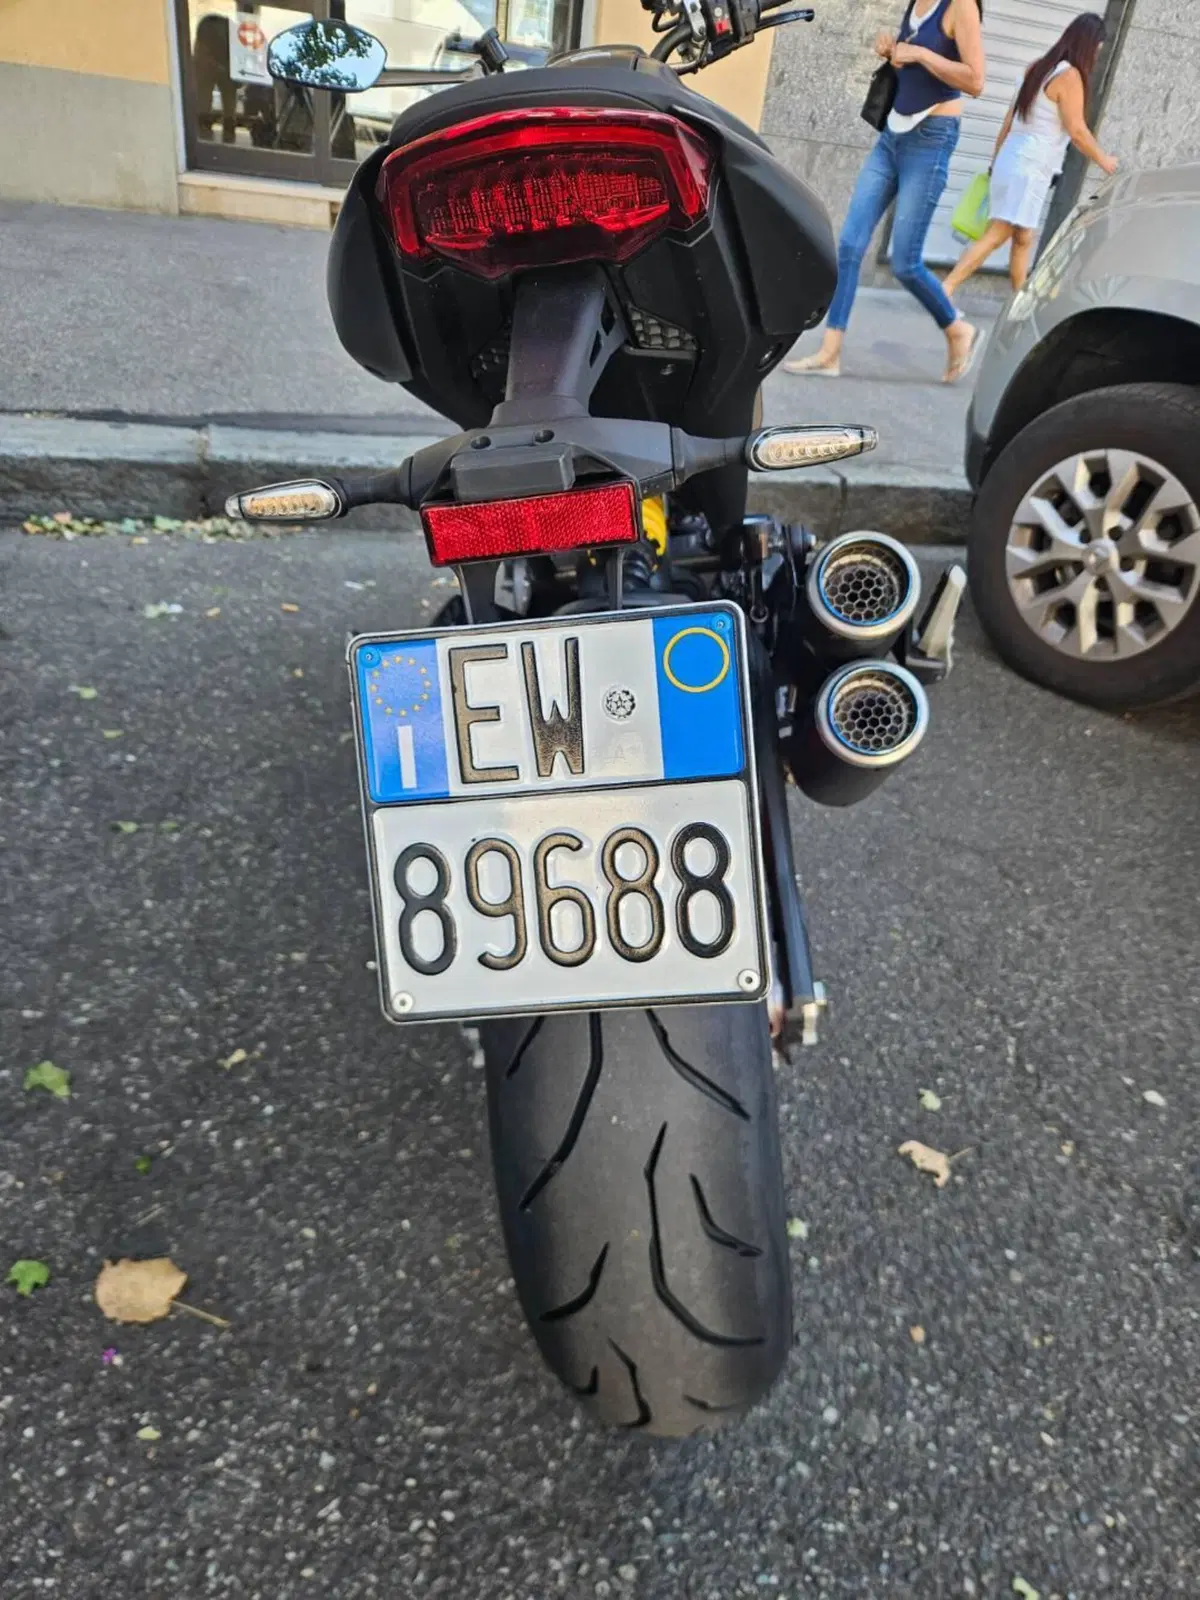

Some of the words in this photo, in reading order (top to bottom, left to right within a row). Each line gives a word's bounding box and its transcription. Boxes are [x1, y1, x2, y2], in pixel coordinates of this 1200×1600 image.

[397, 725, 417, 789] I
[448, 636, 585, 784] EW
[393, 822, 736, 976] 89688
